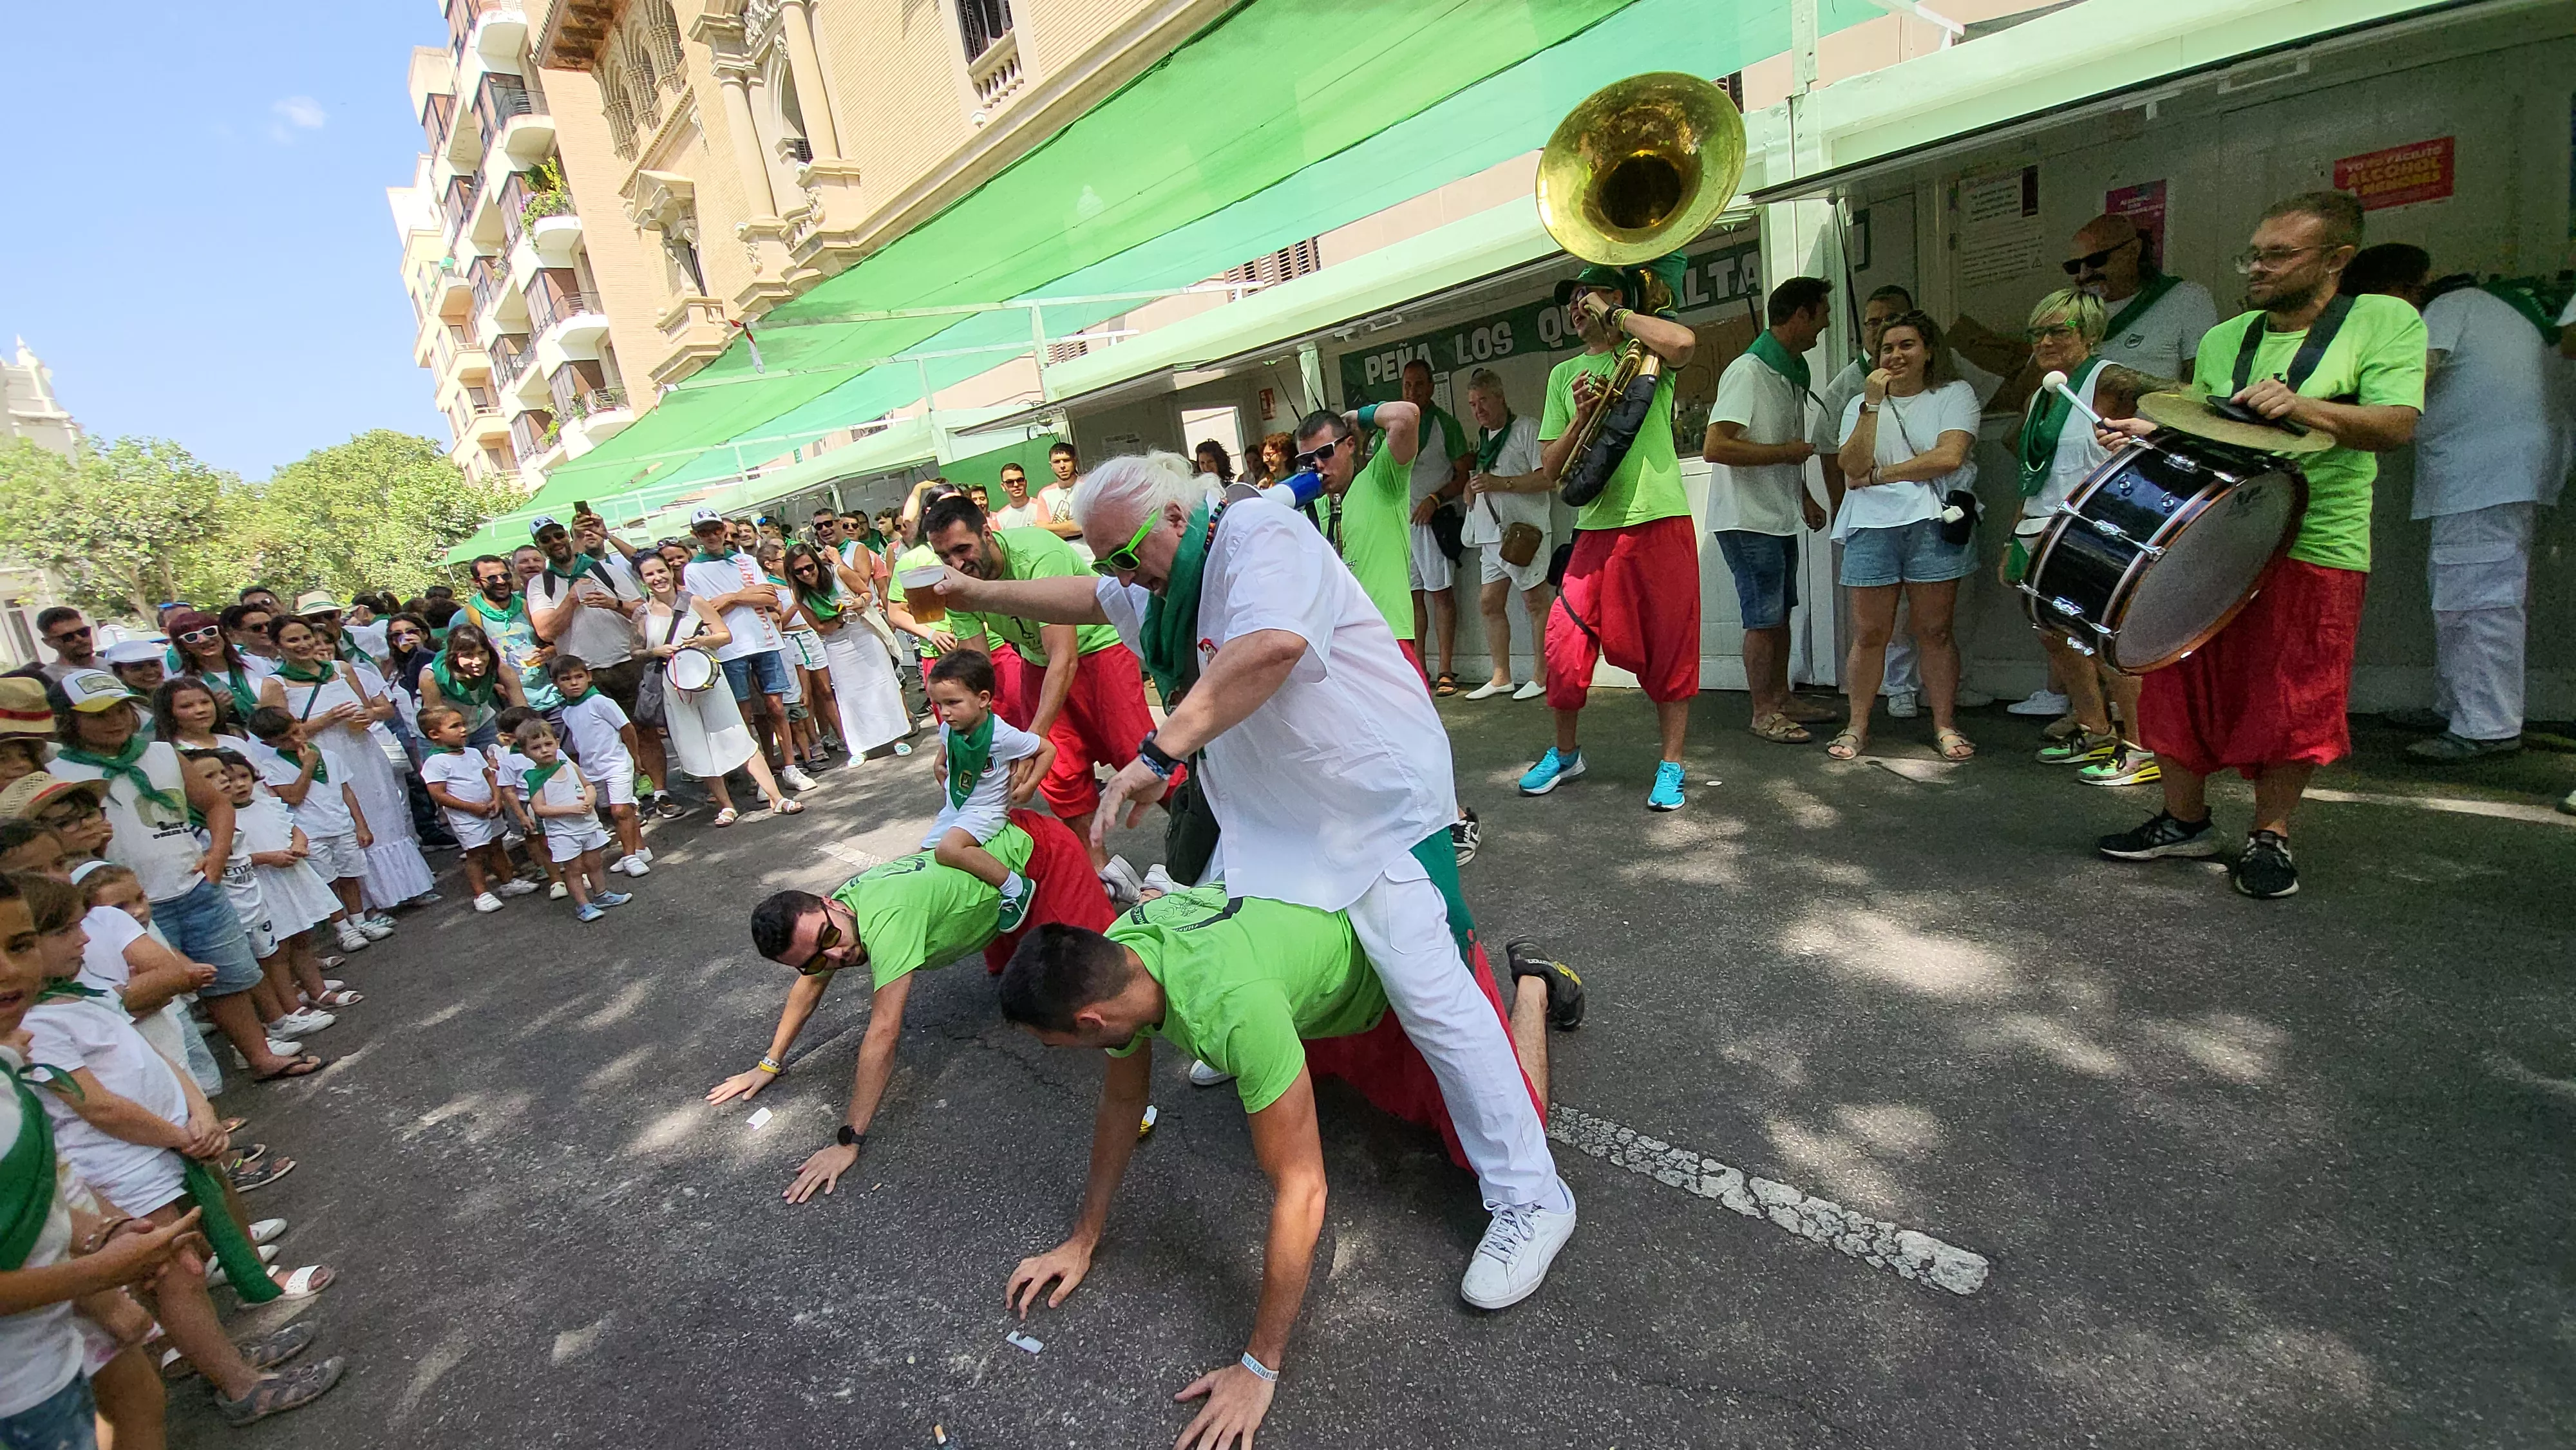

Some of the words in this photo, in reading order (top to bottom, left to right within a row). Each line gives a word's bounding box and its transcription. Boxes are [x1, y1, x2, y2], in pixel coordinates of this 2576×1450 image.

[2346, 156, 2443, 186] ALCOHOL
[1364, 342, 1435, 386] PEÑA
[1455, 321, 1514, 365] LOS
[1537, 304, 1578, 349] QU
